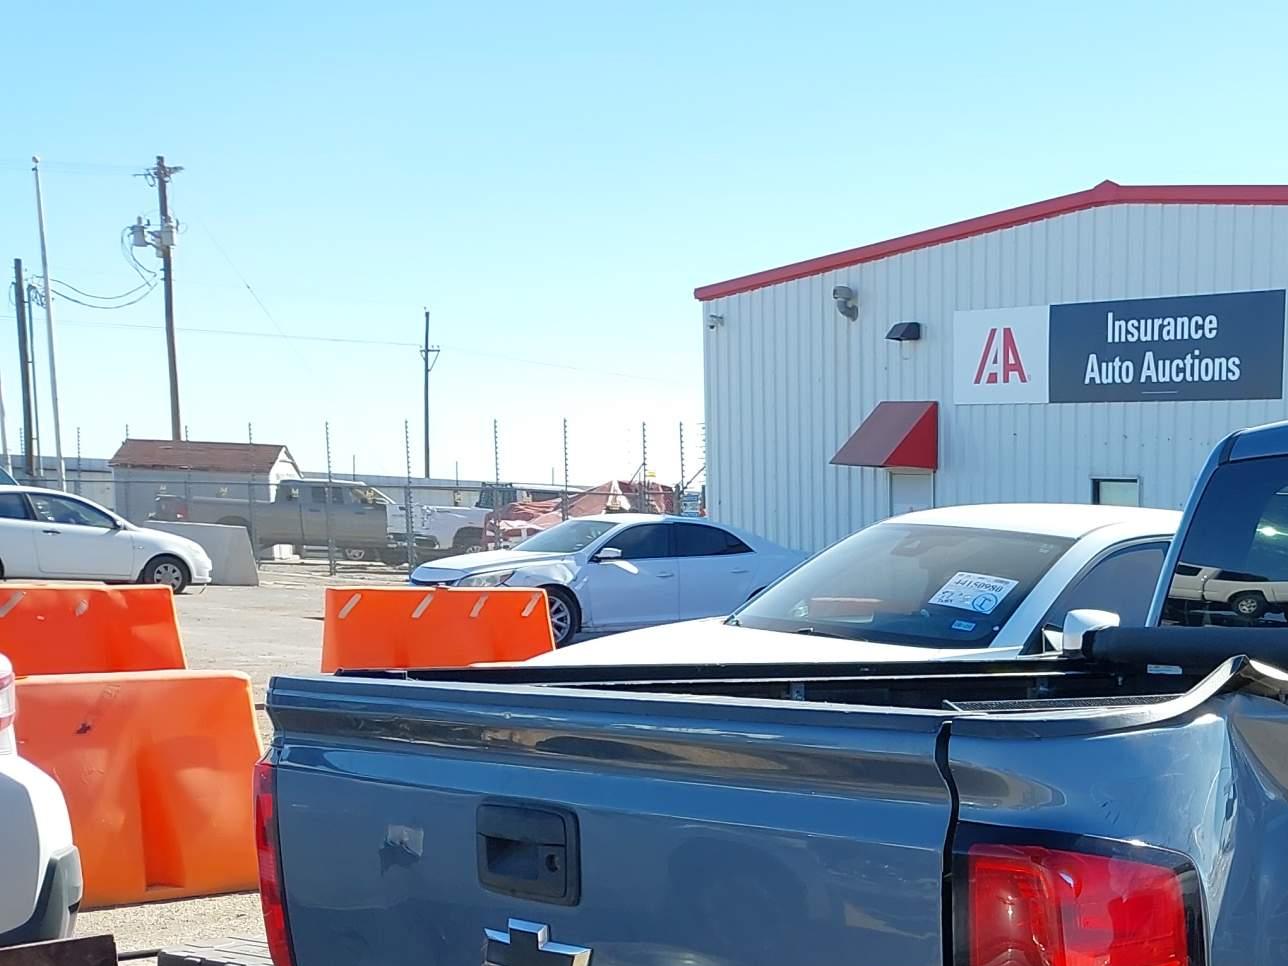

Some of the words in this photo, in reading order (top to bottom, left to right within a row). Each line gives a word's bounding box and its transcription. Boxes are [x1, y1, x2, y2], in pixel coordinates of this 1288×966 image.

[1107, 311, 1218, 343] Insurance
[1084, 353, 1134, 385] Auto
[1140, 349, 1241, 383] Auctions
